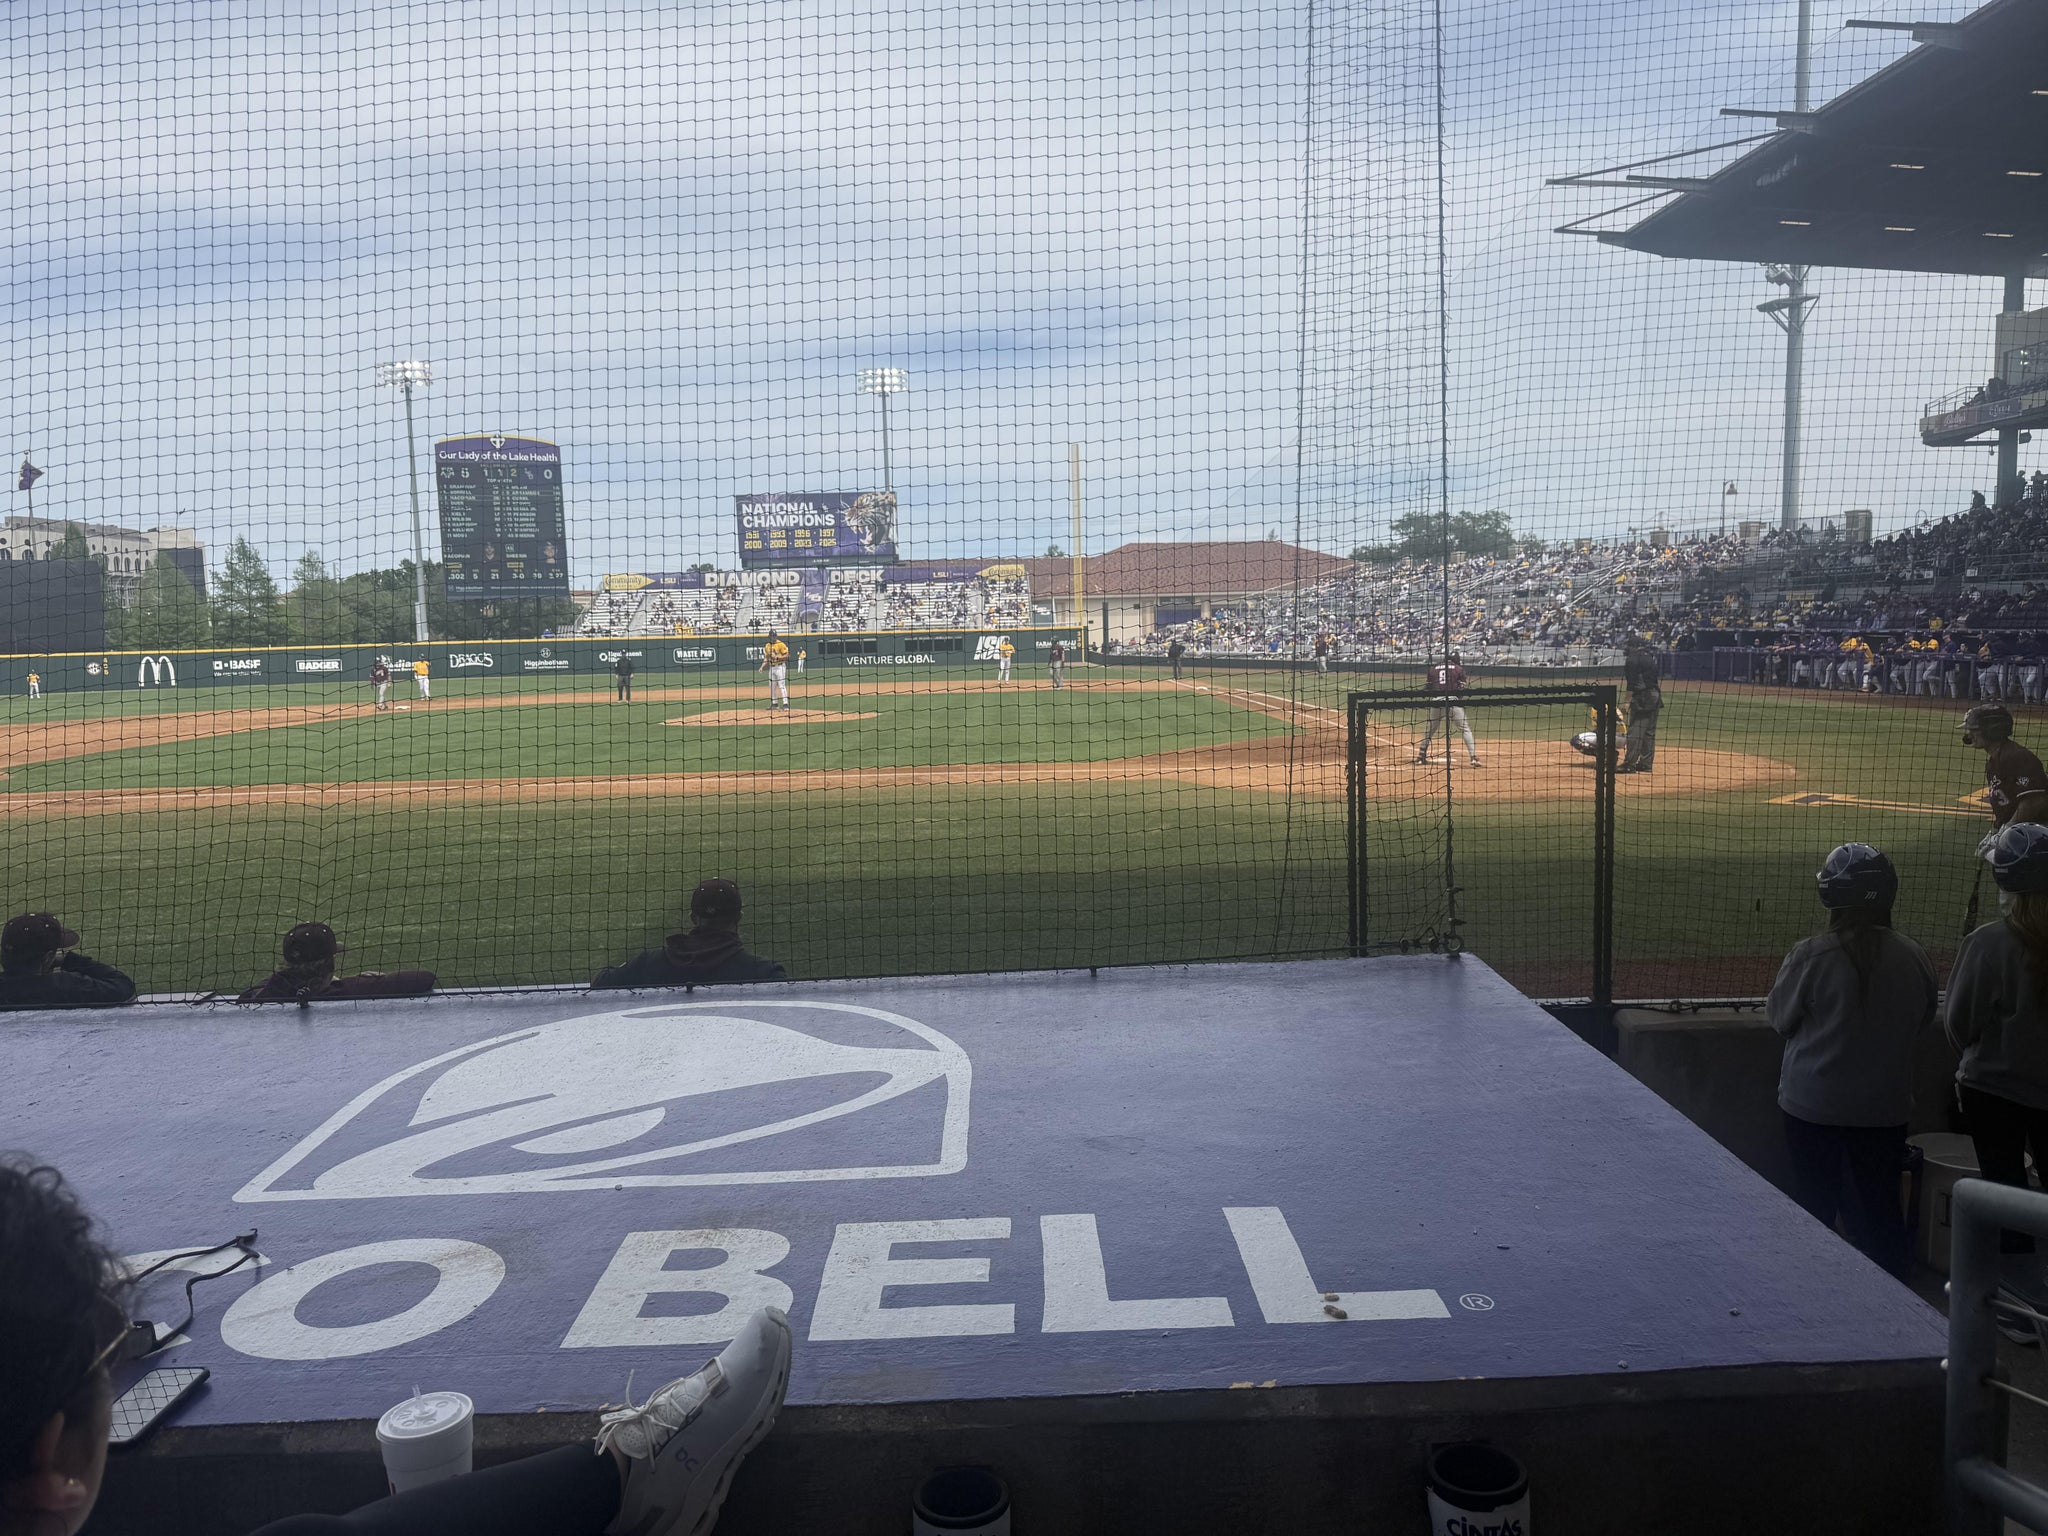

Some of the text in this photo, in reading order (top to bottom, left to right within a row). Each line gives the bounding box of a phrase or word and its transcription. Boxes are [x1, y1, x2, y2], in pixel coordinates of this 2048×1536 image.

[439, 451, 558, 462] Our Lady of the Lake Health
[511, 469, 517, 477] 2
[543, 469, 553, 479] 0
[742, 502, 817, 514] NATIONAL
[743, 514, 835, 528] CHAMPIONS
[704, 571, 800, 587] DIAMOND
[830, 569, 885, 584] DECK
[676, 650, 698, 658] WASTE
[846, 654, 936, 665] VENTURE GLOBAL
[229, 659, 261, 669] BASF
[299, 661, 340, 670] BADGER
[559, 1206, 1452, 1349] BELL
